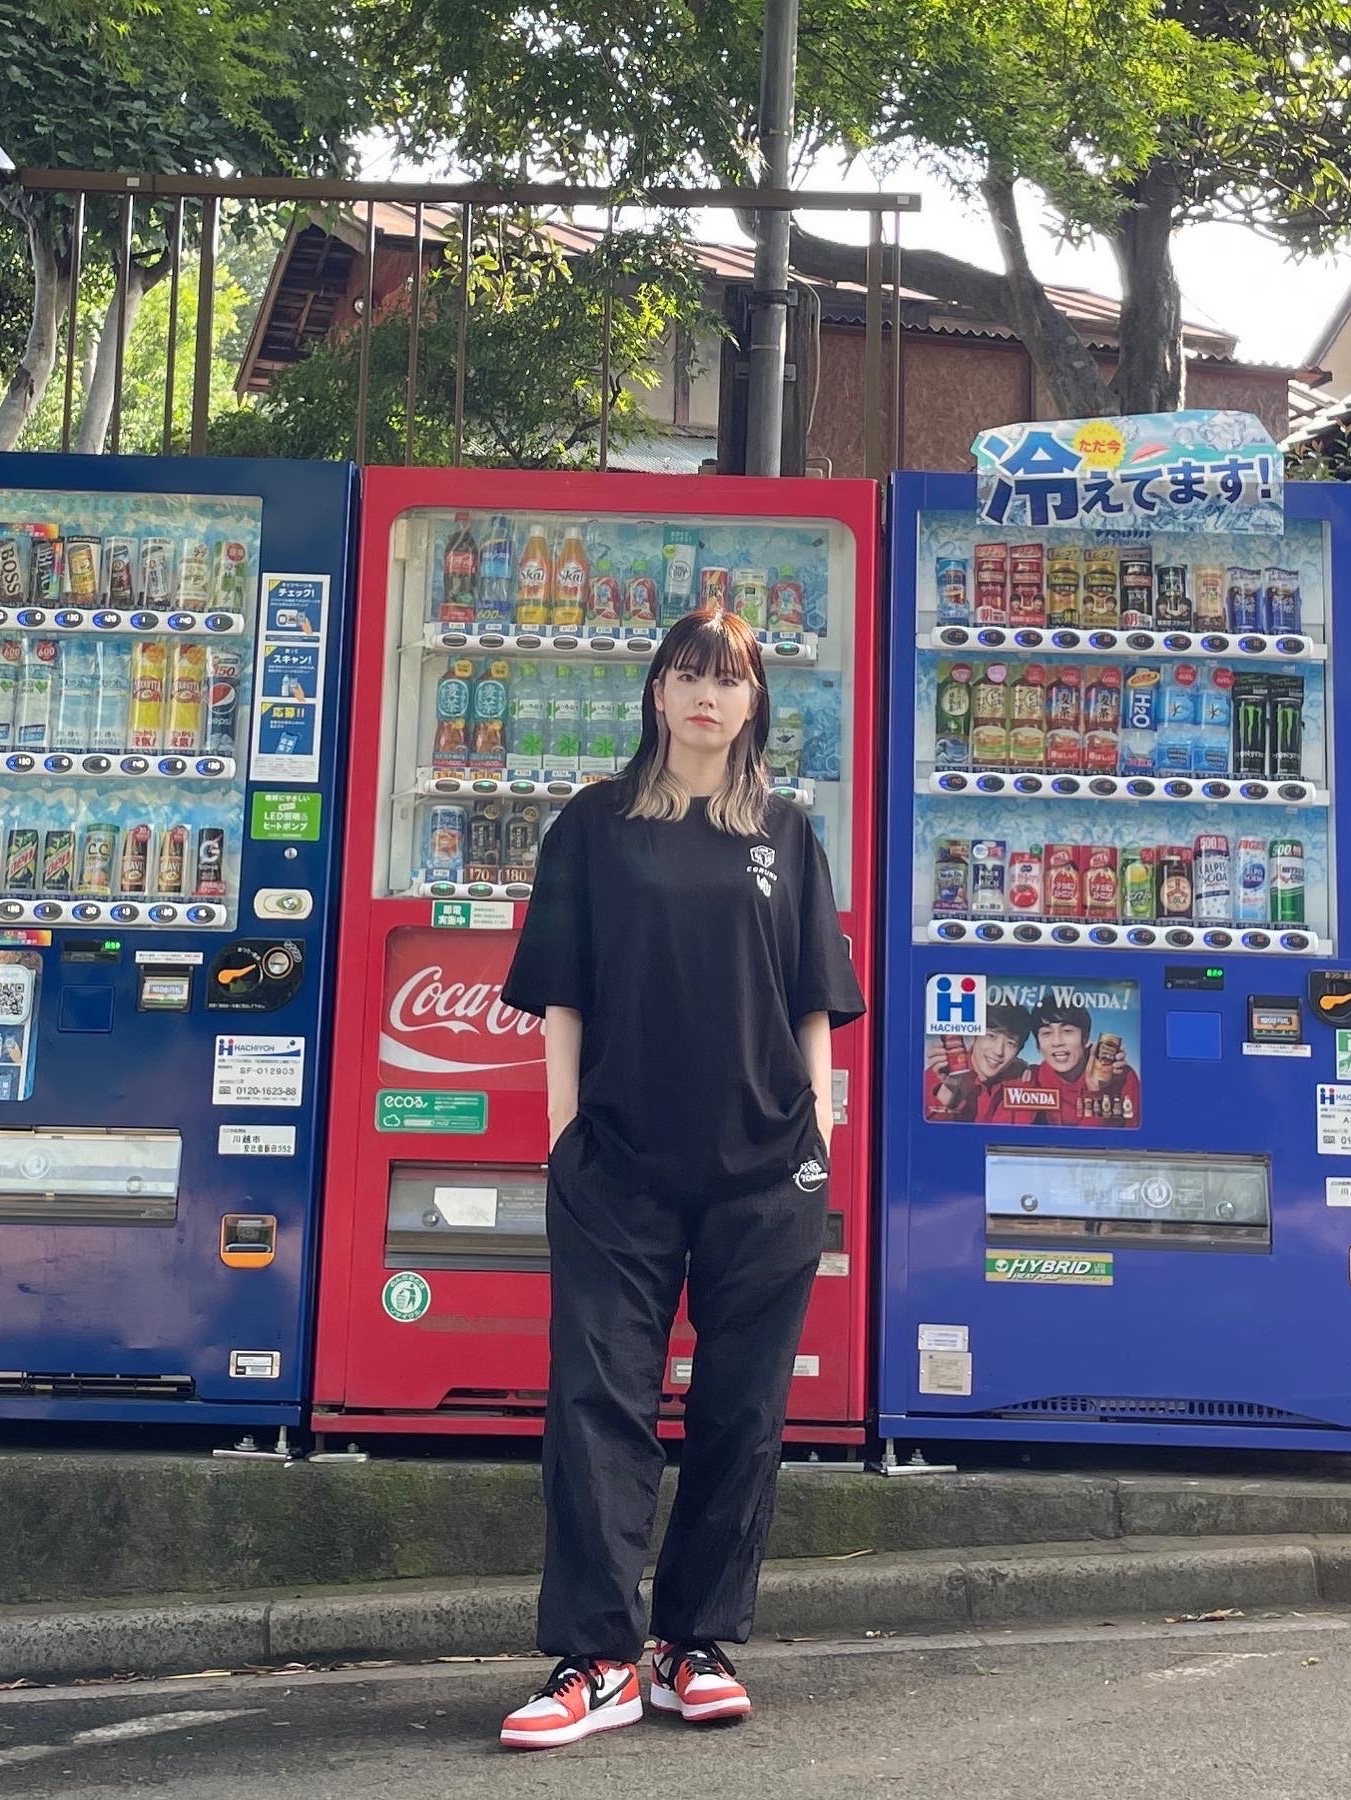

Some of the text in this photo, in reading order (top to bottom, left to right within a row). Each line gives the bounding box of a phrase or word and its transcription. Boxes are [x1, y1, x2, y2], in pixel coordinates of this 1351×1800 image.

[1078, 438, 1121, 455] ただ今
[469, 868, 490, 881] 170
[505, 868, 528, 882] 180
[1050, 985, 1130, 1011] WONDA!
[930, 1023, 982, 1033] HACHIYOH
[1006, 1087, 1056, 1105] WONDA
[232, 1134, 261, 1144] 川越市
[1007, 1258, 1092, 1279] HYBRID
